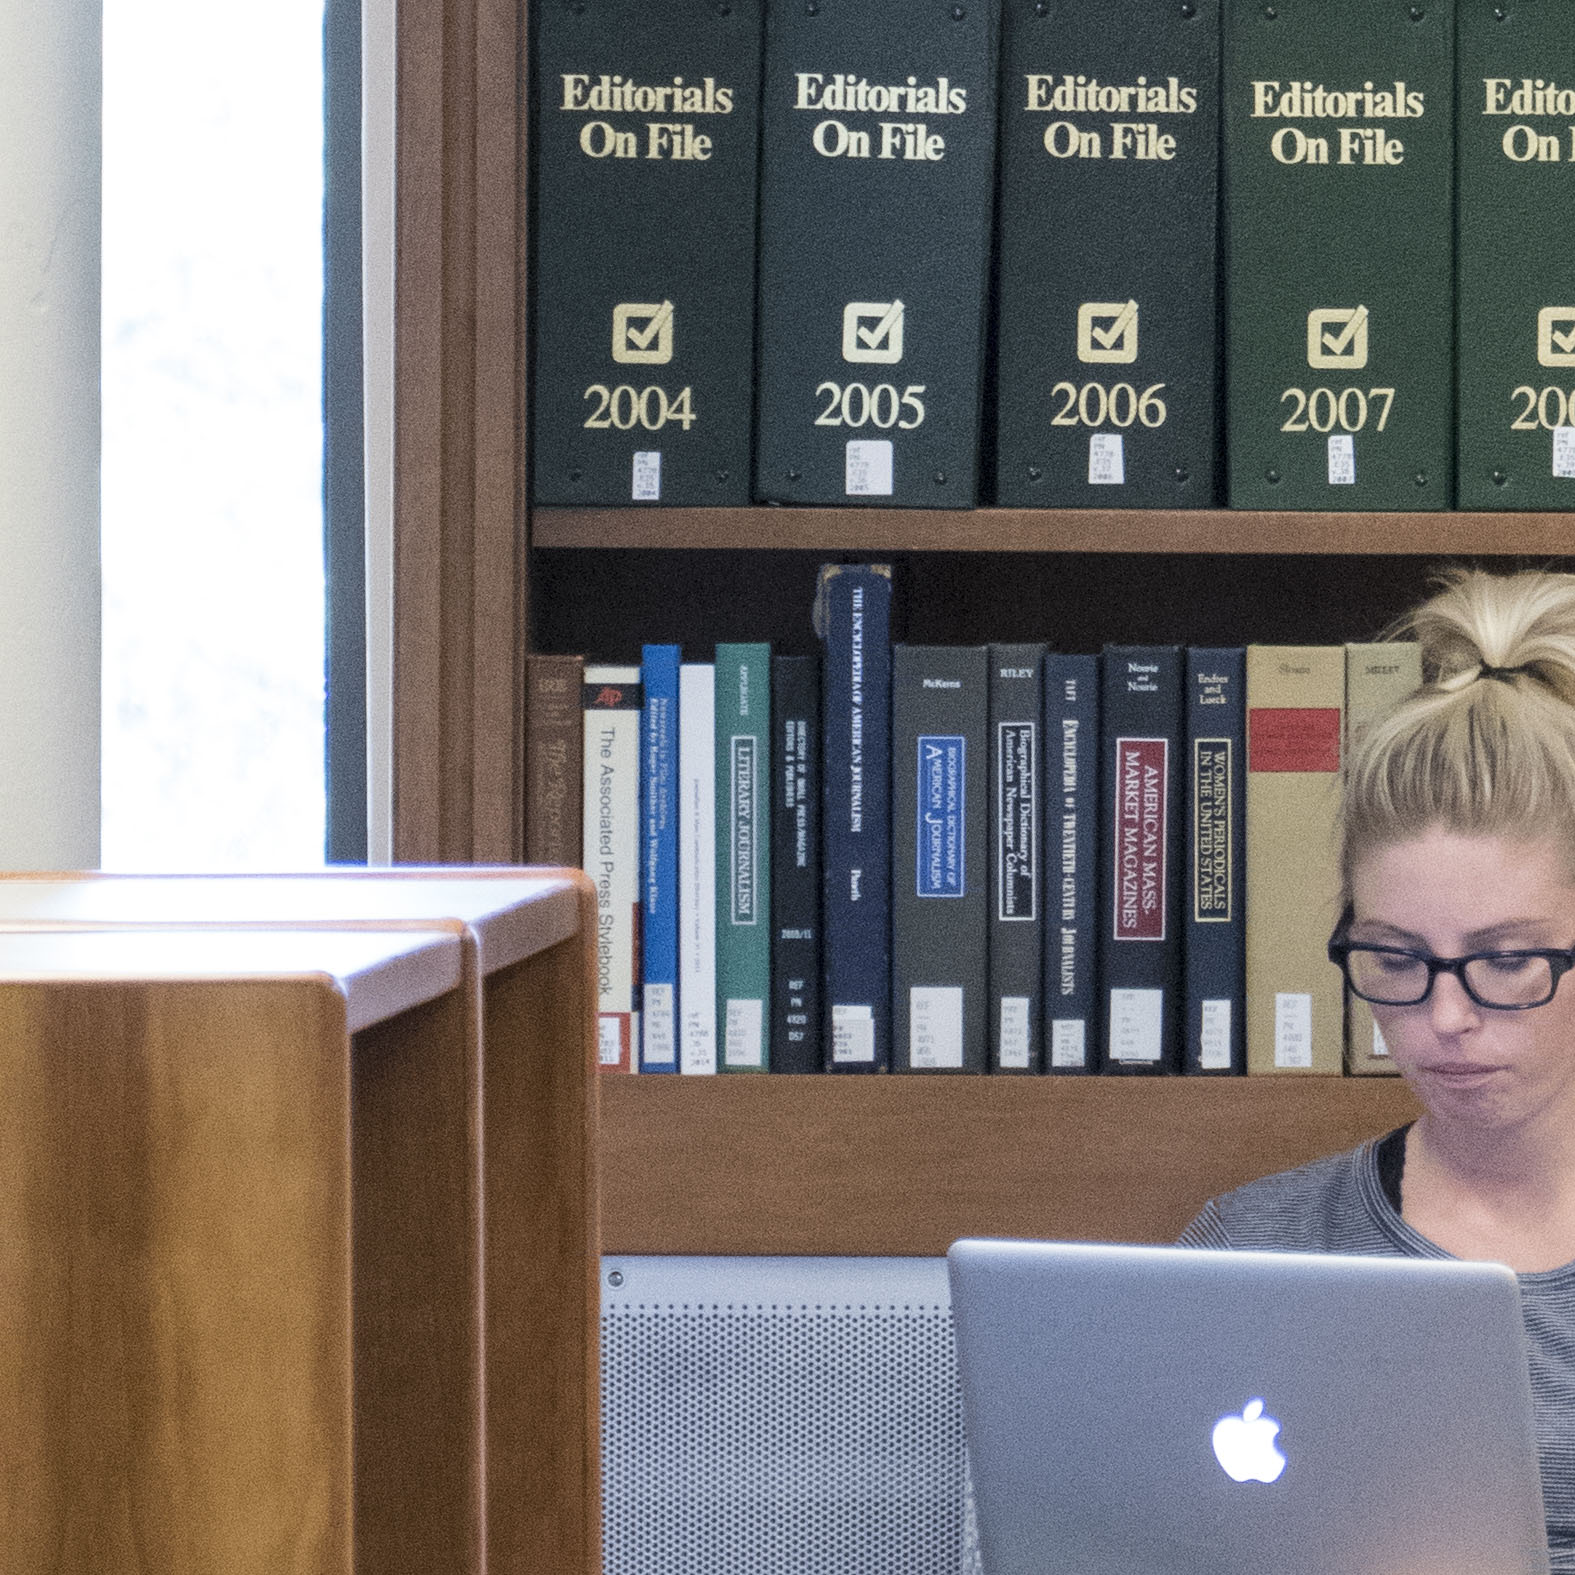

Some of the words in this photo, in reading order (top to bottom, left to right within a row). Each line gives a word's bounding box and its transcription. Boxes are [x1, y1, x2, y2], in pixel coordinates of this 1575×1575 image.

[560, 74, 733, 114] Editorials
[794, 72, 966, 114] Editorials
[1024, 74, 1197, 114] Editorials
[1251, 81, 1424, 118] Editorials
[579, 120, 639, 159] On
[646, 121, 712, 160] File
[812, 120, 870, 159] On
[877, 121, 945, 160] File
[1044, 120, 1102, 159] On
[1109, 121, 1176, 160] File
[1271, 127, 1329, 165] On
[1338, 127, 1404, 165] File
[1502, 125, 1560, 163] On
[583, 385, 695, 431] 2004
[815, 383, 925, 428] 2005
[1051, 383, 1166, 427] 2006
[1280, 388, 1394, 433] 2007
[852, 587, 863, 610] THE
[852, 612, 863, 690] ENCYCLOPEDIA
[1000, 669, 1034, 678] RILEY
[600, 728, 615, 758] The
[851, 708, 862, 763] AMERICAN
[1004, 730, 1016, 782] American
[1062, 720, 1079, 792] ENCYCLOPEDIA
[1200, 751, 1212, 765] IN
[737, 747, 750, 818] LITERARY
[926, 744, 943, 808] AMERICAN
[947, 747, 956, 812] BIOGRAPHICAL
[1017, 730, 1031, 798] Biographical
[1124, 751, 1140, 819] MARKET
[1200, 768, 1212, 800] THE
[1214, 752, 1226, 817] WOMEN'S
[600, 764, 615, 855] Associated
[850, 765, 862, 831] JOURNALISM
[1002, 788, 1016, 848] Newspaper
[1142, 766, 1159, 856] AMERICAN
[925, 812, 943, 889] JOURNALISM
[946, 816, 956, 869] DICTIONARY
[1017, 803, 1031, 860] Dictionary
[1200, 804, 1212, 852] UNITED
[598, 862, 614, 908] Press
[737, 821, 750, 914] JOURNALISM
[945, 872, 956, 886] OF
[1004, 853, 1016, 915] Columnists
[1019, 865, 1031, 876] of
[1122, 826, 1139, 929] MAGAZINES
[1141, 859, 1156, 915] MASS-
[1200, 854, 1212, 911] STATES
[1214, 820, 1226, 910] PERIODICALS
[598, 914, 614, 996] Stylebook
[1060, 928, 1077, 995] JOURNALISTS
